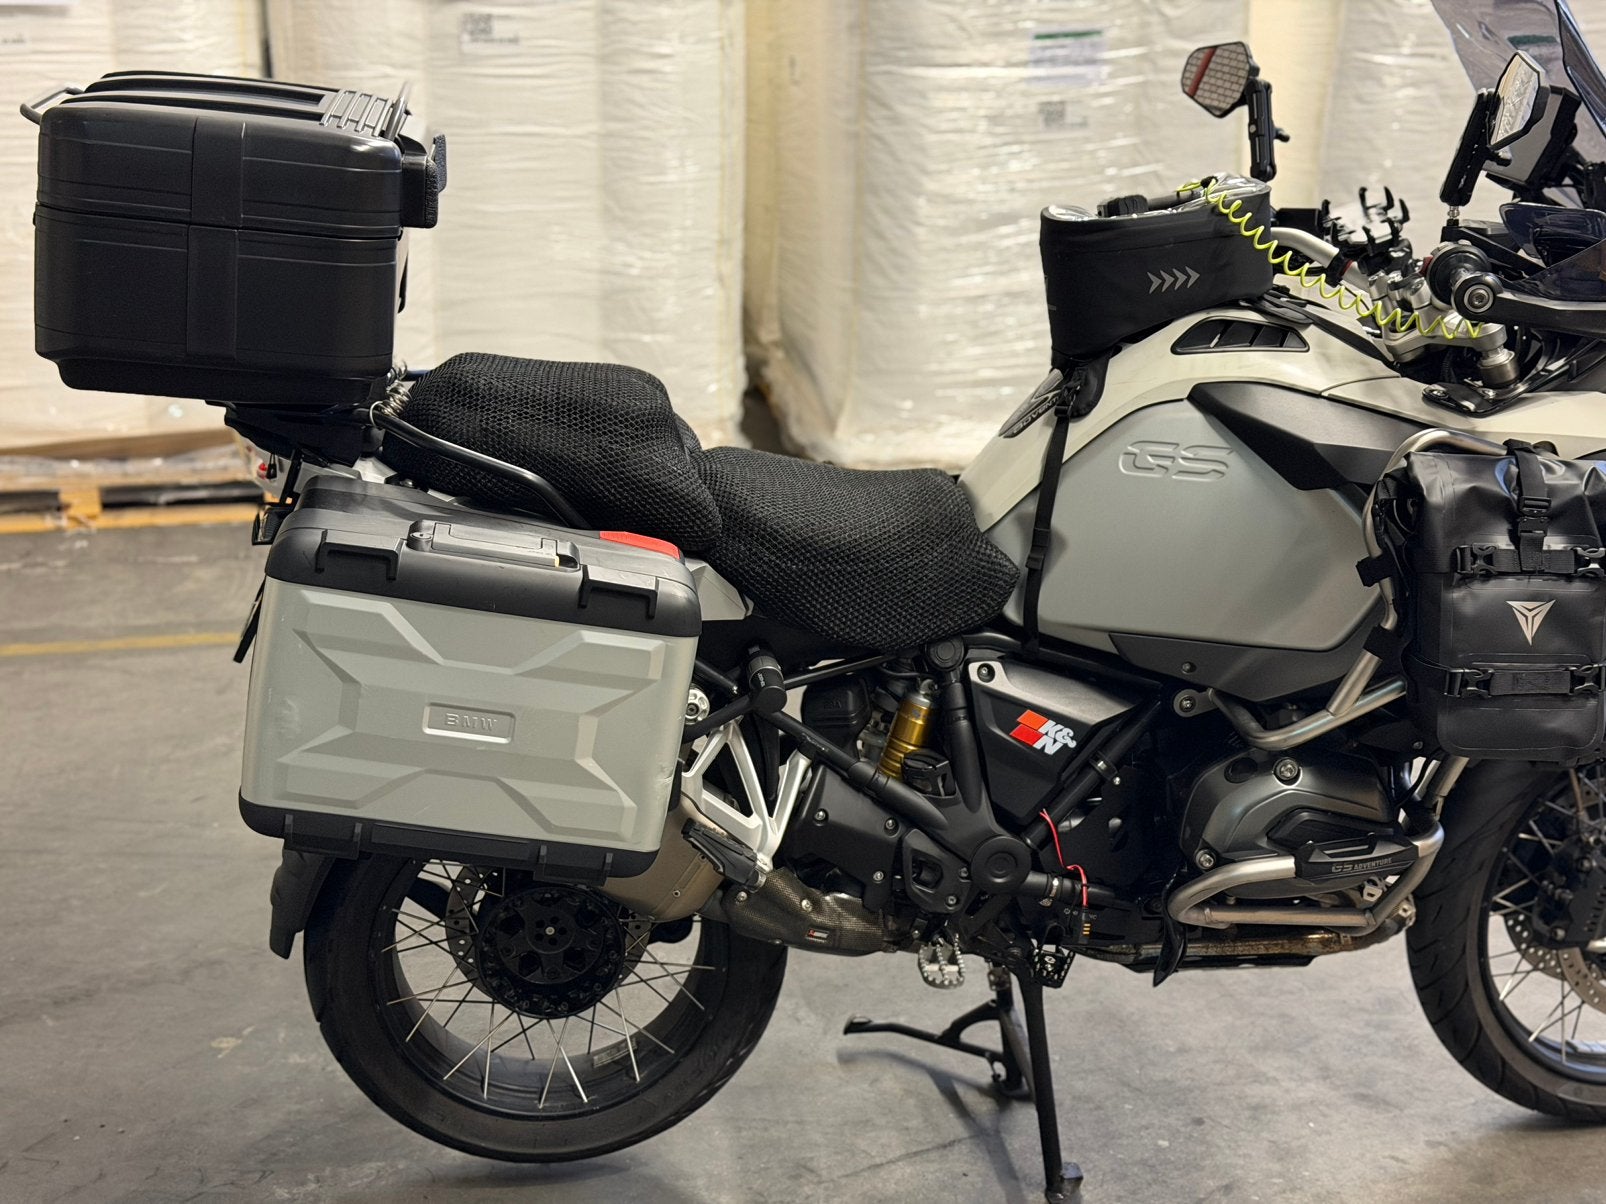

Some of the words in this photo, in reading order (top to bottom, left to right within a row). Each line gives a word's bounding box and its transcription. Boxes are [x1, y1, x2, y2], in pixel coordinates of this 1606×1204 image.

[1119, 440, 1234, 482] GS
[445, 712, 498, 731] BMW
[1034, 719, 1077, 755] K&N
[1331, 862, 1353, 873] GS
[1353, 857, 1393, 871] ADVENTURE
